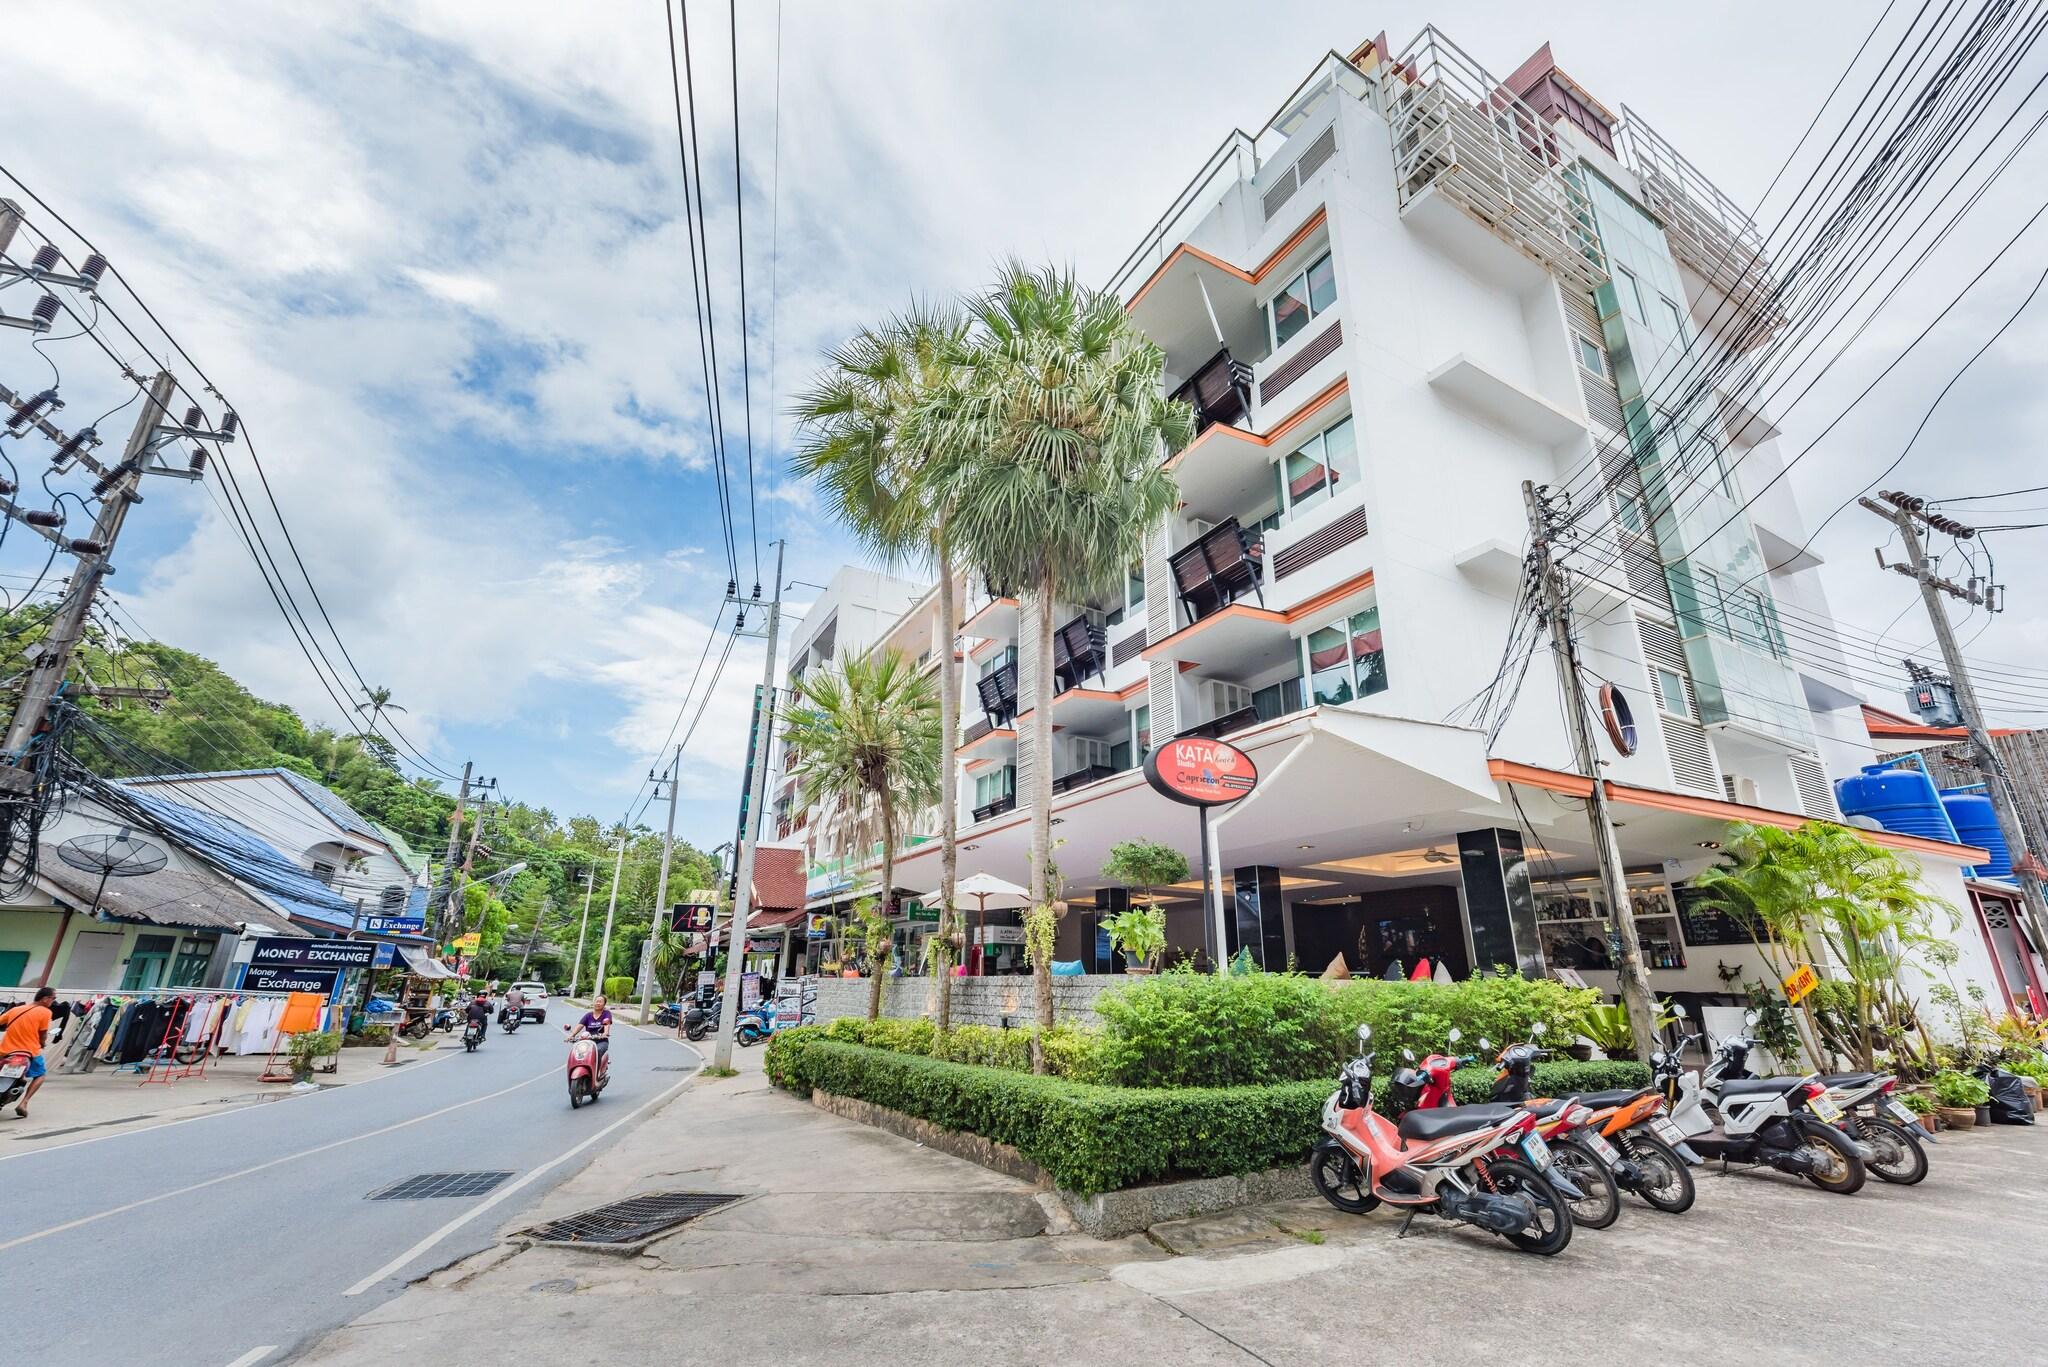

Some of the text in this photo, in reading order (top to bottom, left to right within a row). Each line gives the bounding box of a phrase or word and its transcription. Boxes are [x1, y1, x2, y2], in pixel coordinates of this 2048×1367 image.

[1176, 744, 1213, 763] KATA
[1177, 760, 1196, 768] Studio
[382, 921, 420, 931] Exchange
[258, 948, 303, 959] MONEY
[307, 950, 370, 963] EXCHANGE
[249, 967, 278, 978] Money
[257, 977, 322, 992] Exchange
